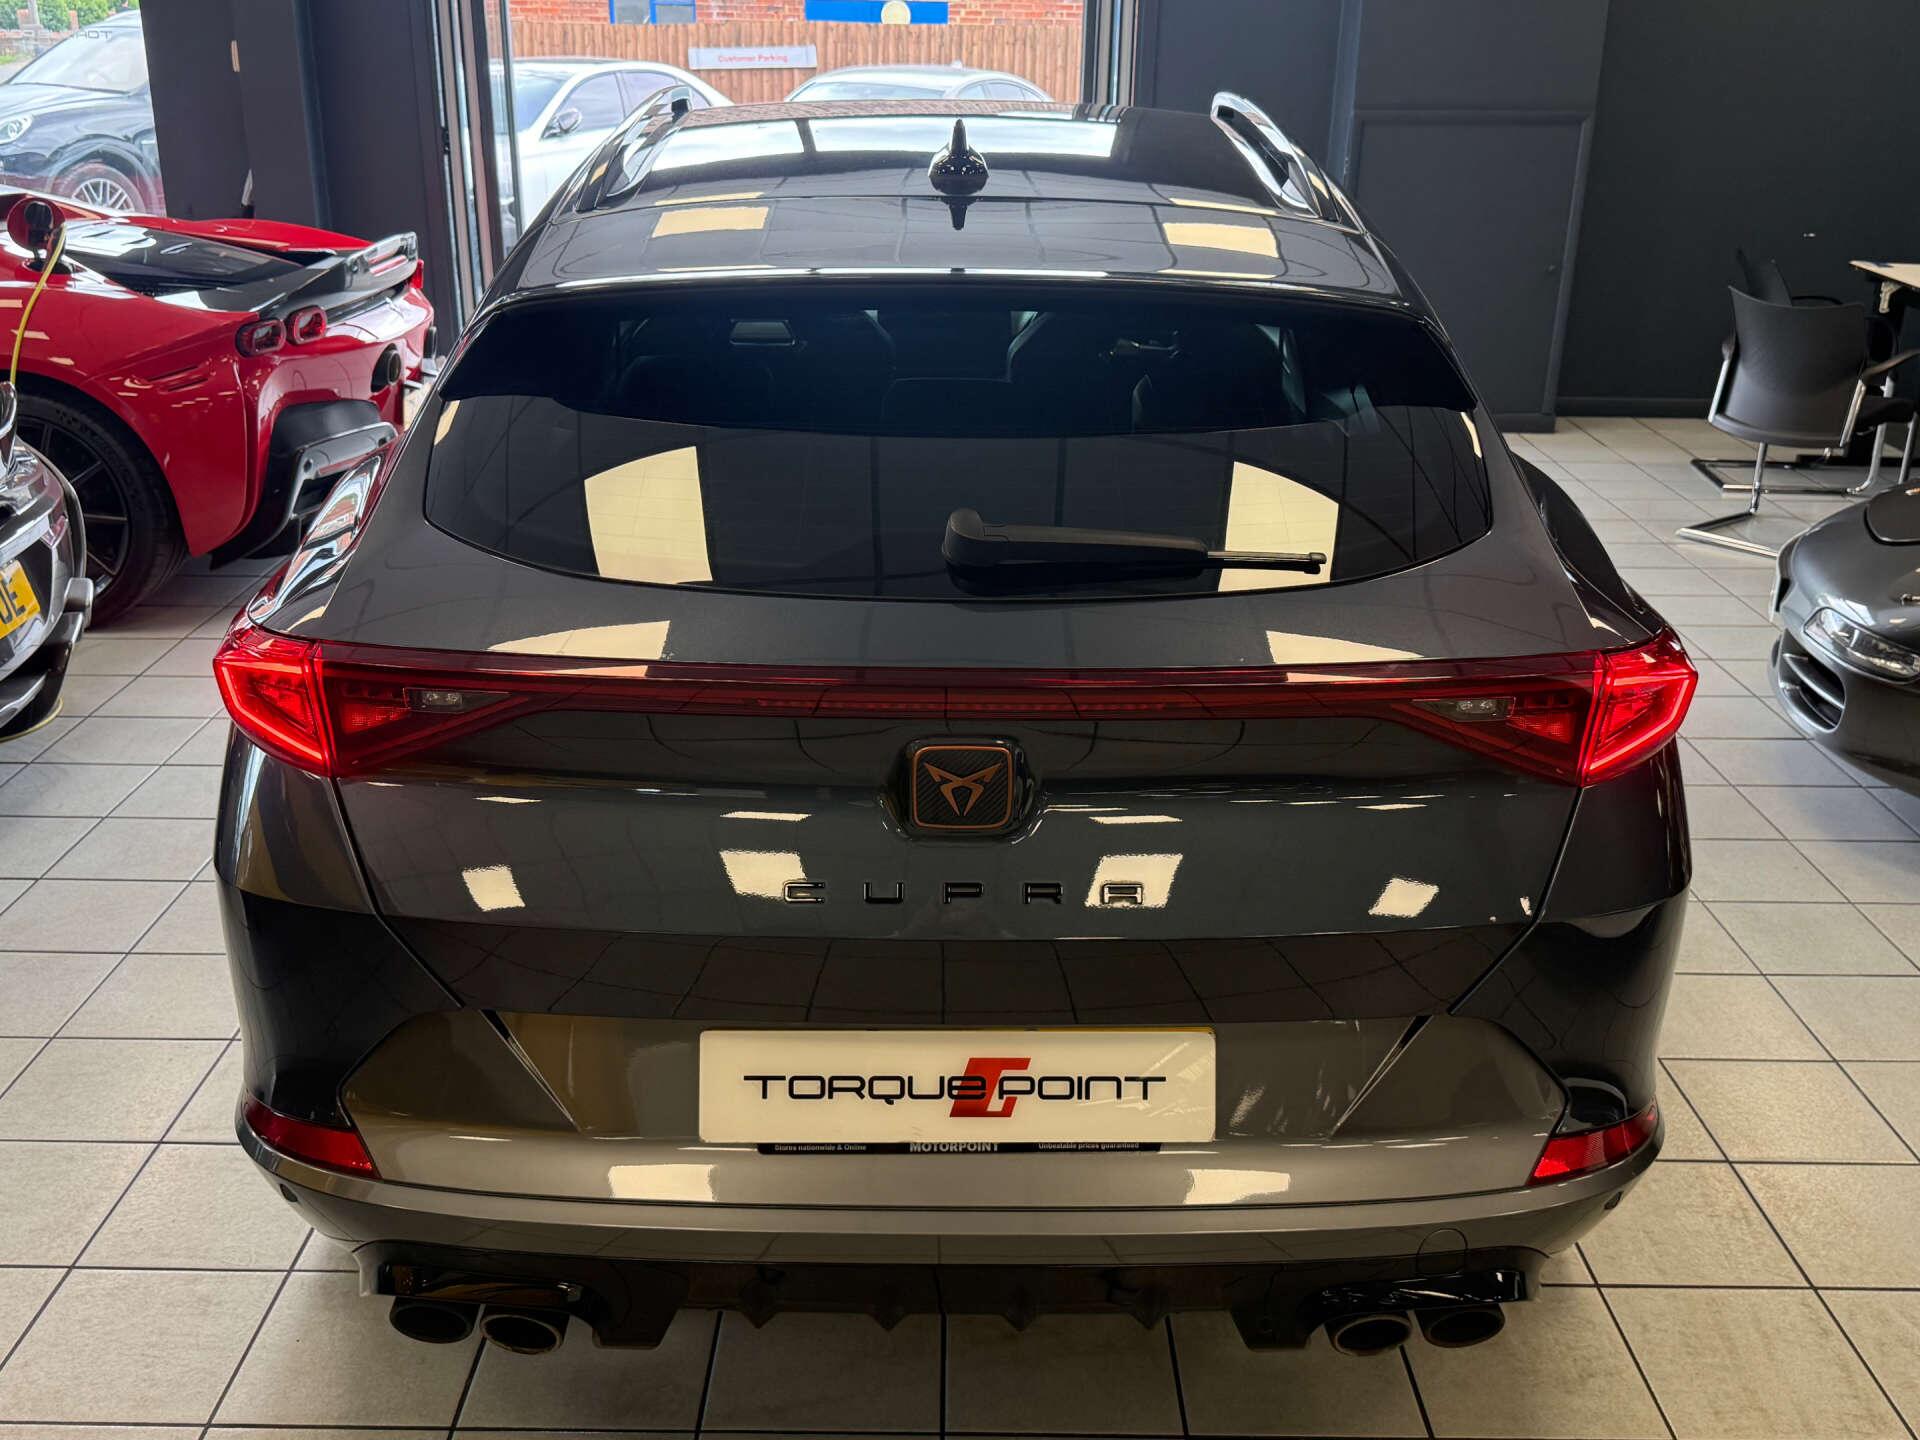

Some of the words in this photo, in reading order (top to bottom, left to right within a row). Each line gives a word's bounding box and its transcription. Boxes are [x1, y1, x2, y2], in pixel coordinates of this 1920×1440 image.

[719, 55, 754, 63] Customer
[758, 54, 788, 63] Parking
[783, 880, 1144, 905] CUPRA
[743, 1075, 987, 1105] TORQUE
[998, 1075, 1167, 1100] POINT
[909, 1142, 999, 1153] MOTORPOINT
